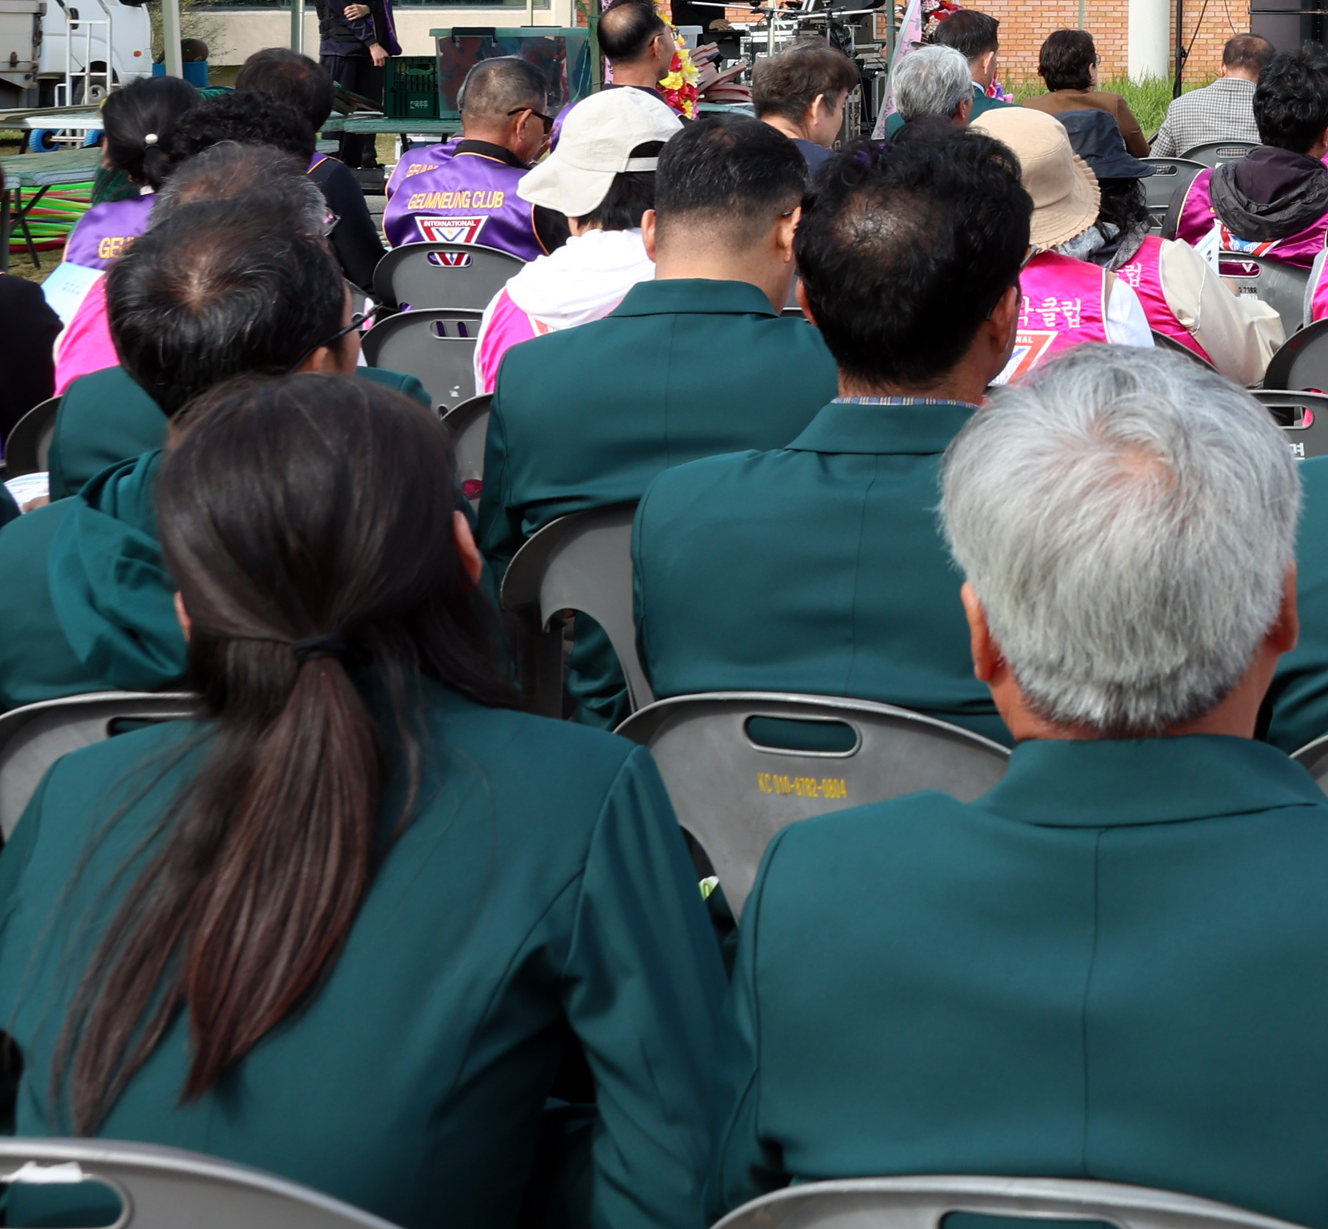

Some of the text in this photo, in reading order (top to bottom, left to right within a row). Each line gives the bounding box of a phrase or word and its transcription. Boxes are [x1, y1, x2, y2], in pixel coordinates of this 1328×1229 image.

[407, 190, 505, 210] GEUMNEUNG CLUB
[423, 219, 477, 228] INTERNATIONAL
